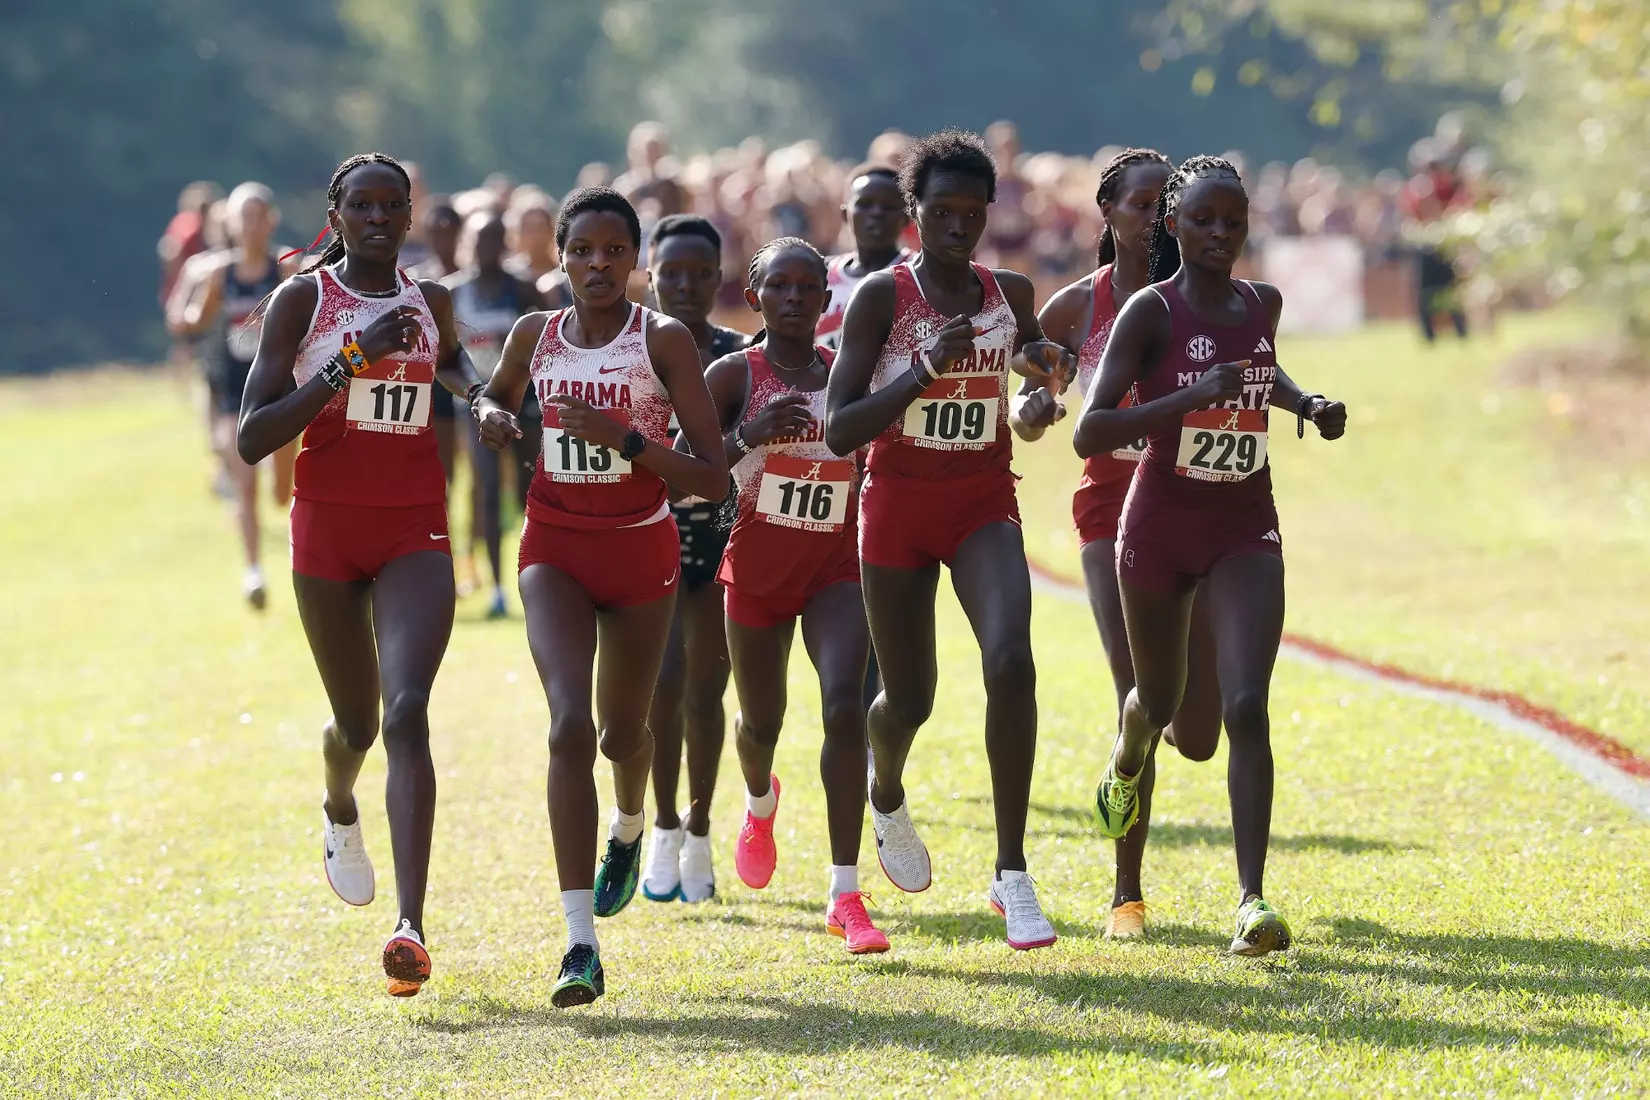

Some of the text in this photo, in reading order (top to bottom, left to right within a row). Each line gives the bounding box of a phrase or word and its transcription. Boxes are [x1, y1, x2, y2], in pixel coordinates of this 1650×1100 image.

[337, 310, 354, 325] SEC
[915, 321, 932, 339] SEC
[1188, 337, 1215, 360] SEC
[370, 383, 418, 422] 117
[357, 421, 419, 435] CRIMSON CLASSIC
[921, 401, 986, 440] 109
[556, 434, 612, 471] 113
[914, 438, 985, 451] CRIMSON CLASSIC
[1189, 431, 1257, 473] 229
[552, 473, 620, 484] CRIMSON CLASSIC
[1186, 468, 1222, 482] CRIMSON
[778, 481, 833, 520] 116
[766, 515, 834, 532] CRIMSON CLASSIC
